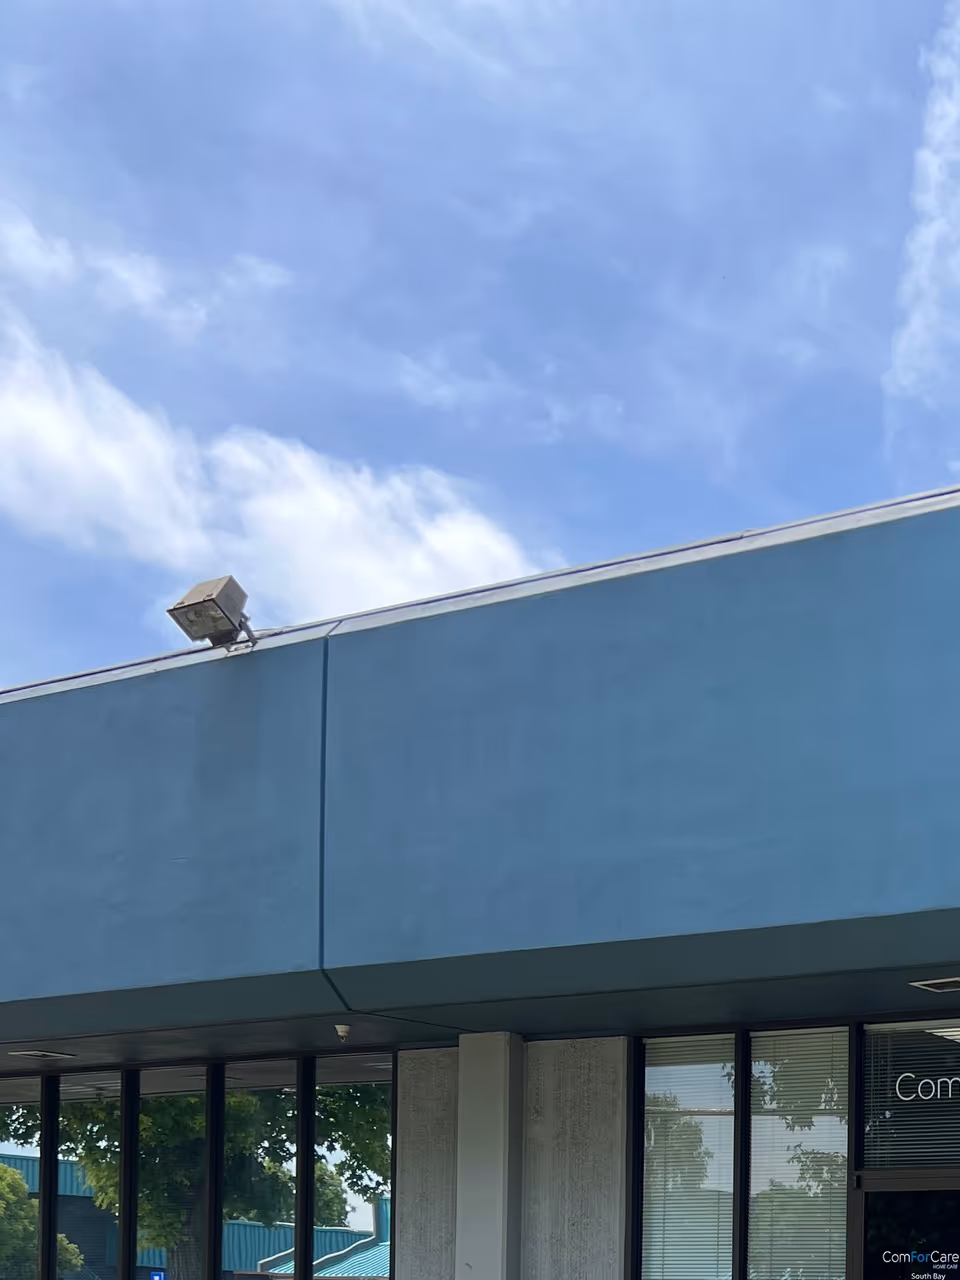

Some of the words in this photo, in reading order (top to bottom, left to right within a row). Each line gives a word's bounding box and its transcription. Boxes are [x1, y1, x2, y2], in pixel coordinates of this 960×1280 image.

[882, 1250, 960, 1263] ComForCare
[911, 1272, 932, 1280] South
[933, 1272, 946, 1280] Bay
